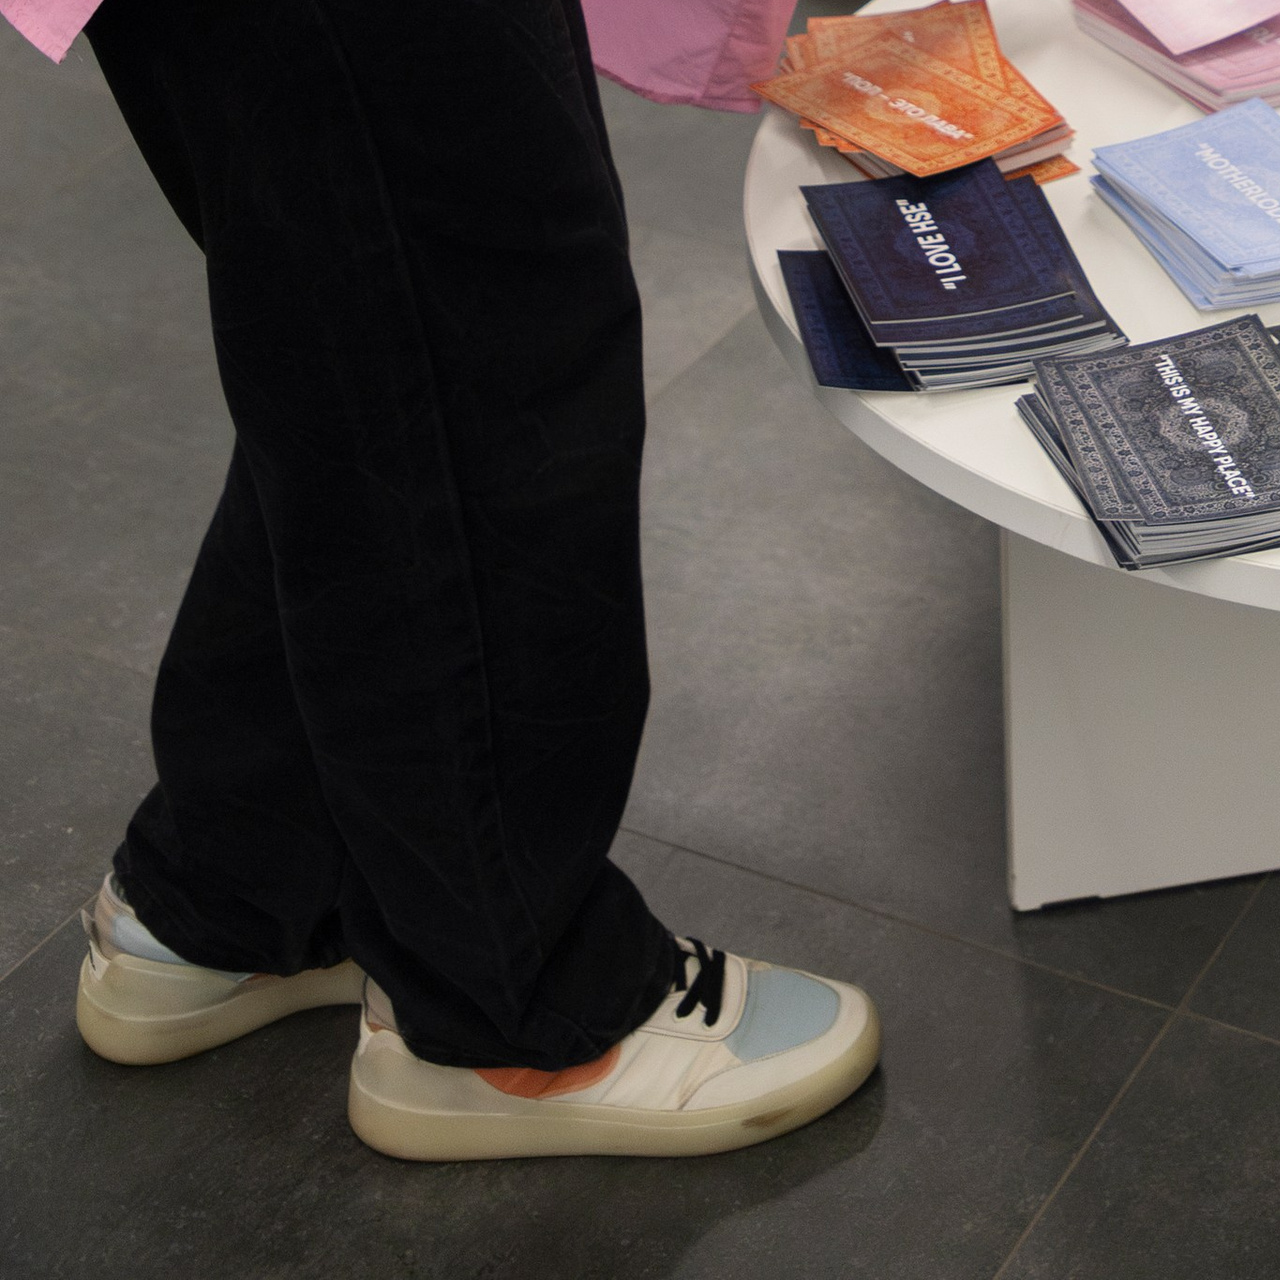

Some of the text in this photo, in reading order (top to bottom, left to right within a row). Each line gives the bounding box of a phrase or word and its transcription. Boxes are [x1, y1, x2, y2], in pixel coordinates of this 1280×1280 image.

[888, 98, 926, 119] ЭТО
[923, 114, 975, 140] ЛАВА"
[895, 199, 939, 234] HSE"
[916, 233, 962, 274] LOVE
[1155, 354, 1256, 498] "THIS IS MY HAPPY PLACE"
